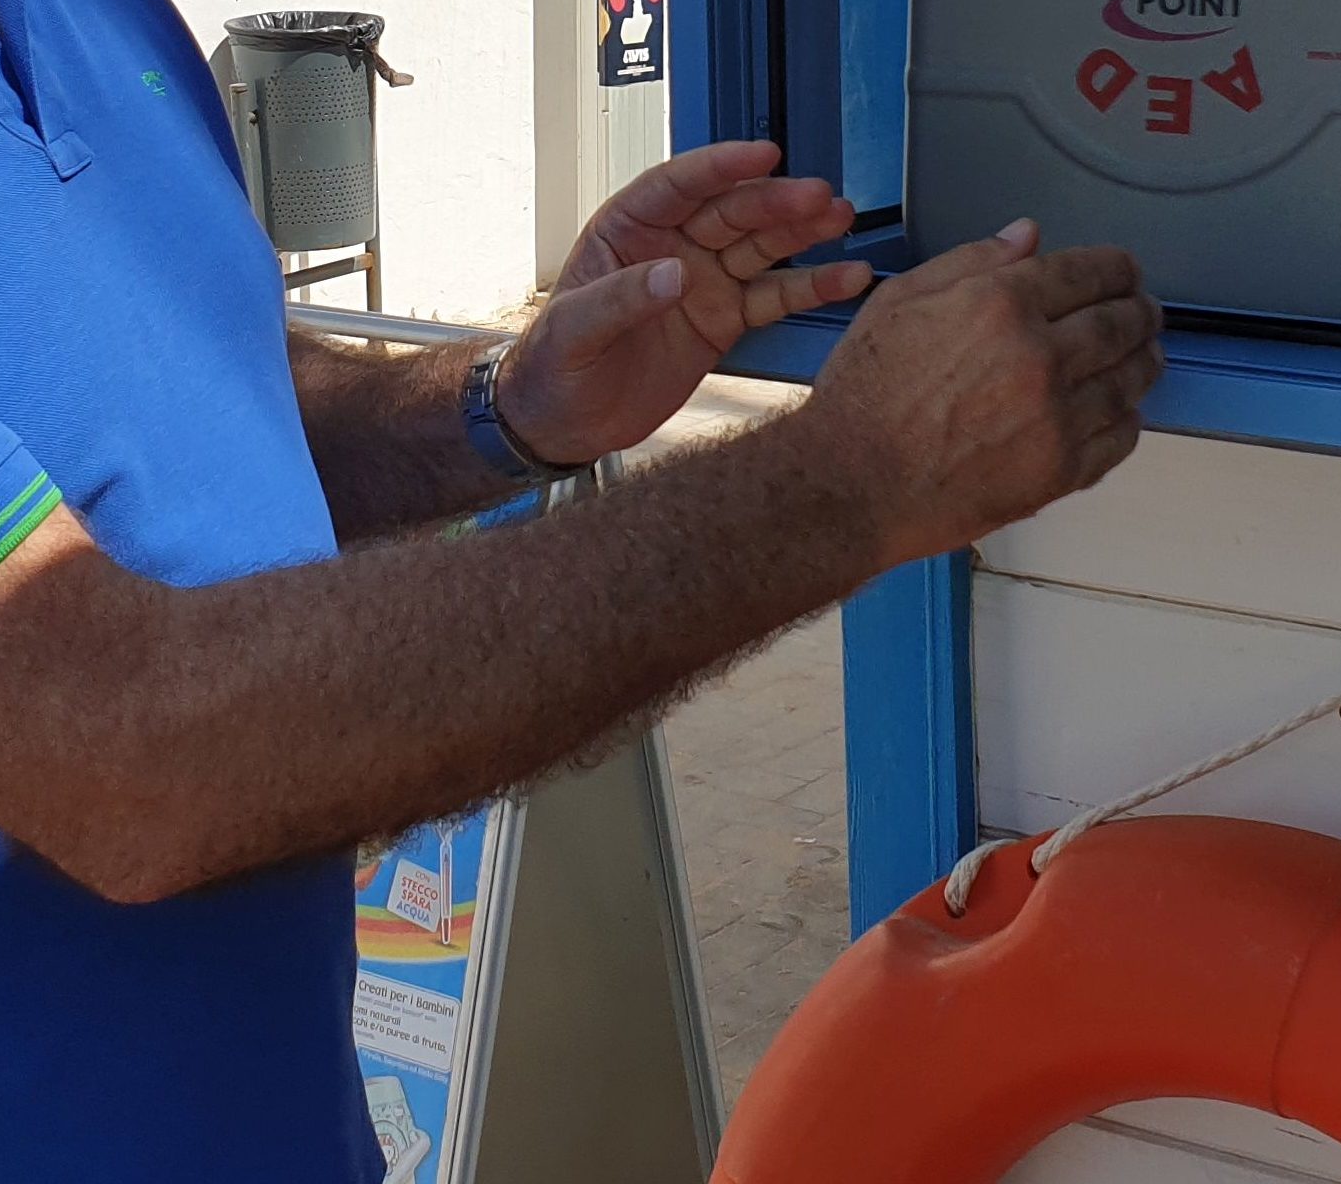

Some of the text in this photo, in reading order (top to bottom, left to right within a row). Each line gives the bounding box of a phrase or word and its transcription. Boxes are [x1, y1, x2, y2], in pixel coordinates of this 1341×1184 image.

[1075, 43, 1265, 136] AED
[401, 876, 439, 901] STECCO
[415, 870, 431, 884] CON
[396, 900, 430, 923] ACQUA
[401, 889, 432, 912] SPARA
[358, 979, 388, 998] Creati
[389, 989, 408, 1003] per
[409, 994, 414, 1006] i
[416, 997, 455, 1019] Bambini
[369, 1009, 401, 1026] naturali
[369, 1022, 385, 1033] e/o
[412, 1034, 420, 1044] di
